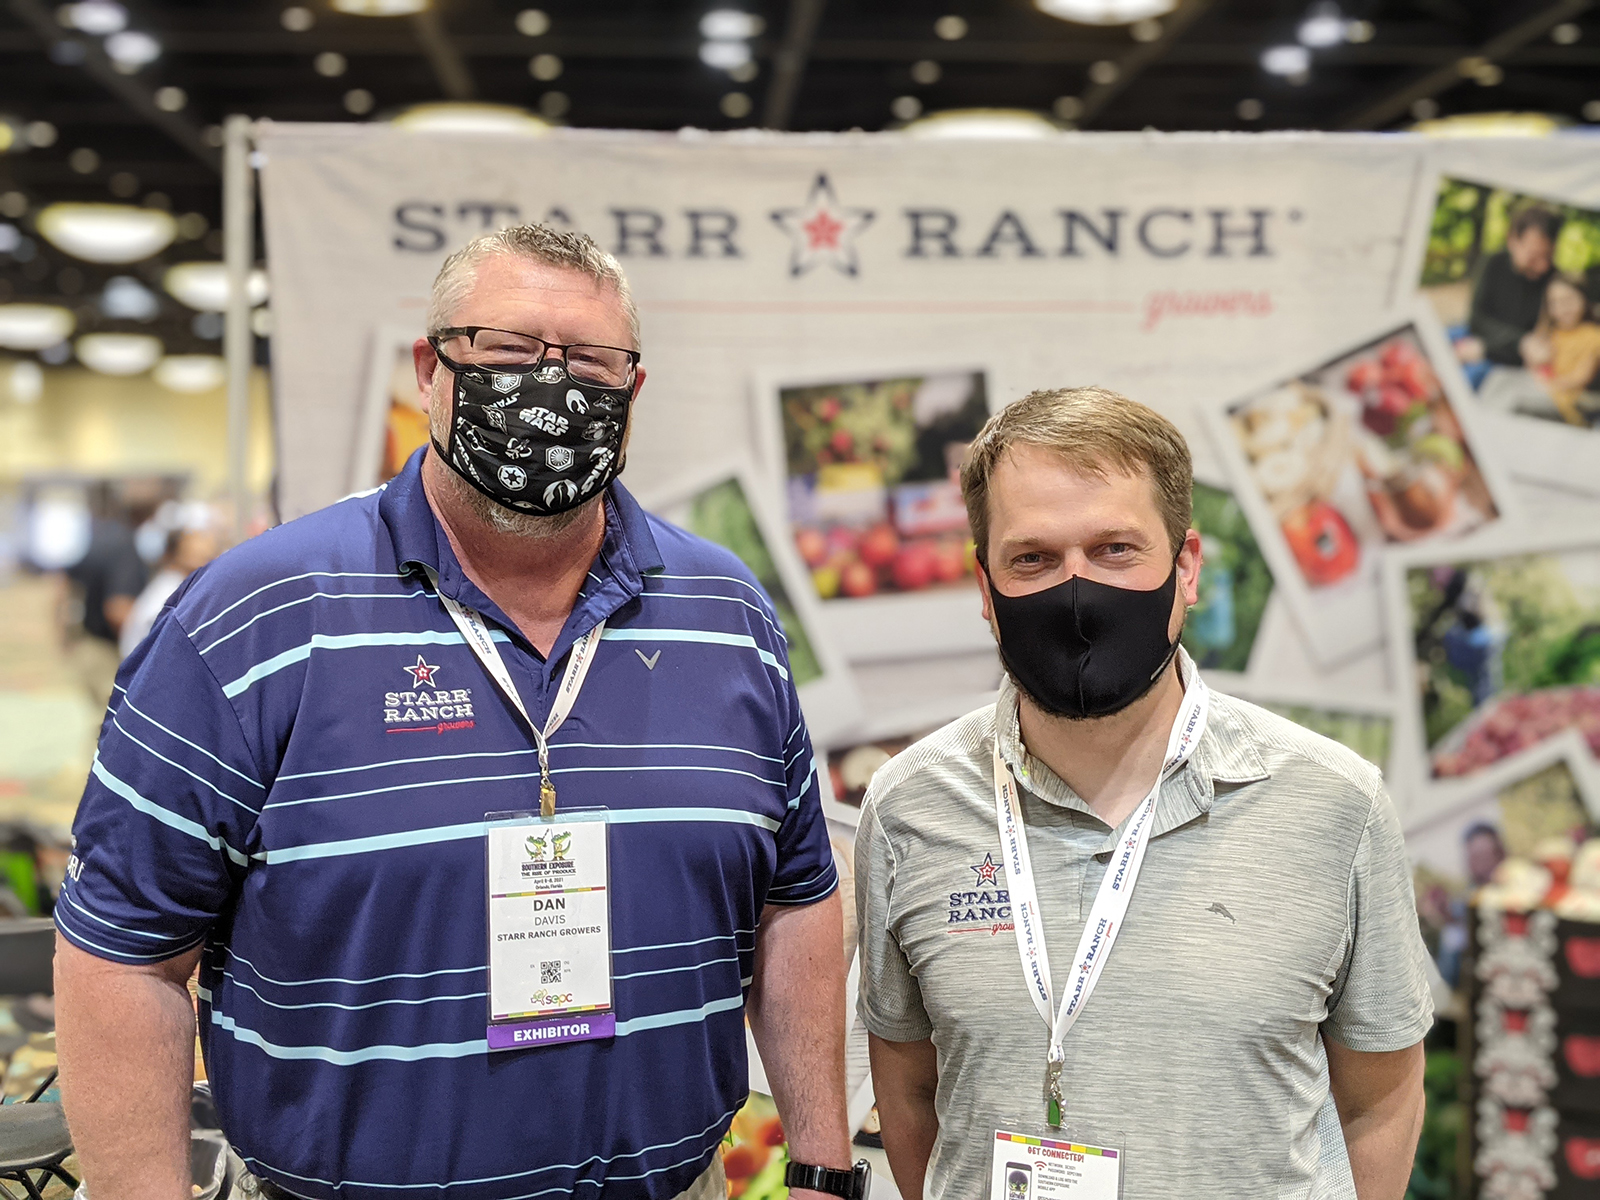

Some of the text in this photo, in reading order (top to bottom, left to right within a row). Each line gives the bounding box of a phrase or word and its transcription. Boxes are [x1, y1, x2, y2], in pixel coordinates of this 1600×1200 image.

[392, 202, 744, 259] STRR
[518, 410, 567, 436] WARS
[522, 406, 569, 430] STAR
[565, 630, 593, 694] STARR RAN
[384, 689, 471, 708] STARR
[383, 703, 475, 723] RANCH
[1163, 704, 1202, 774] STARR RANC
[1010, 837, 1021, 876] STARR
[1112, 851, 1131, 891] STARR
[533, 897, 566, 912] DAN
[949, 890, 1011, 907] STAR
[534, 914, 566, 927] DAVIS
[948, 906, 1012, 923] RANC
[497, 926, 602, 942] STARR RANCH GROWERS
[991, 922, 1015, 936] grow
[1020, 902, 1049, 1001] STARR RANCH
[1066, 917, 1107, 1016] STARR RANCH
[513, 1023, 590, 1042] EXHIBITOR
[1027, 1146, 1085, 1163] GET CONNECTED!
